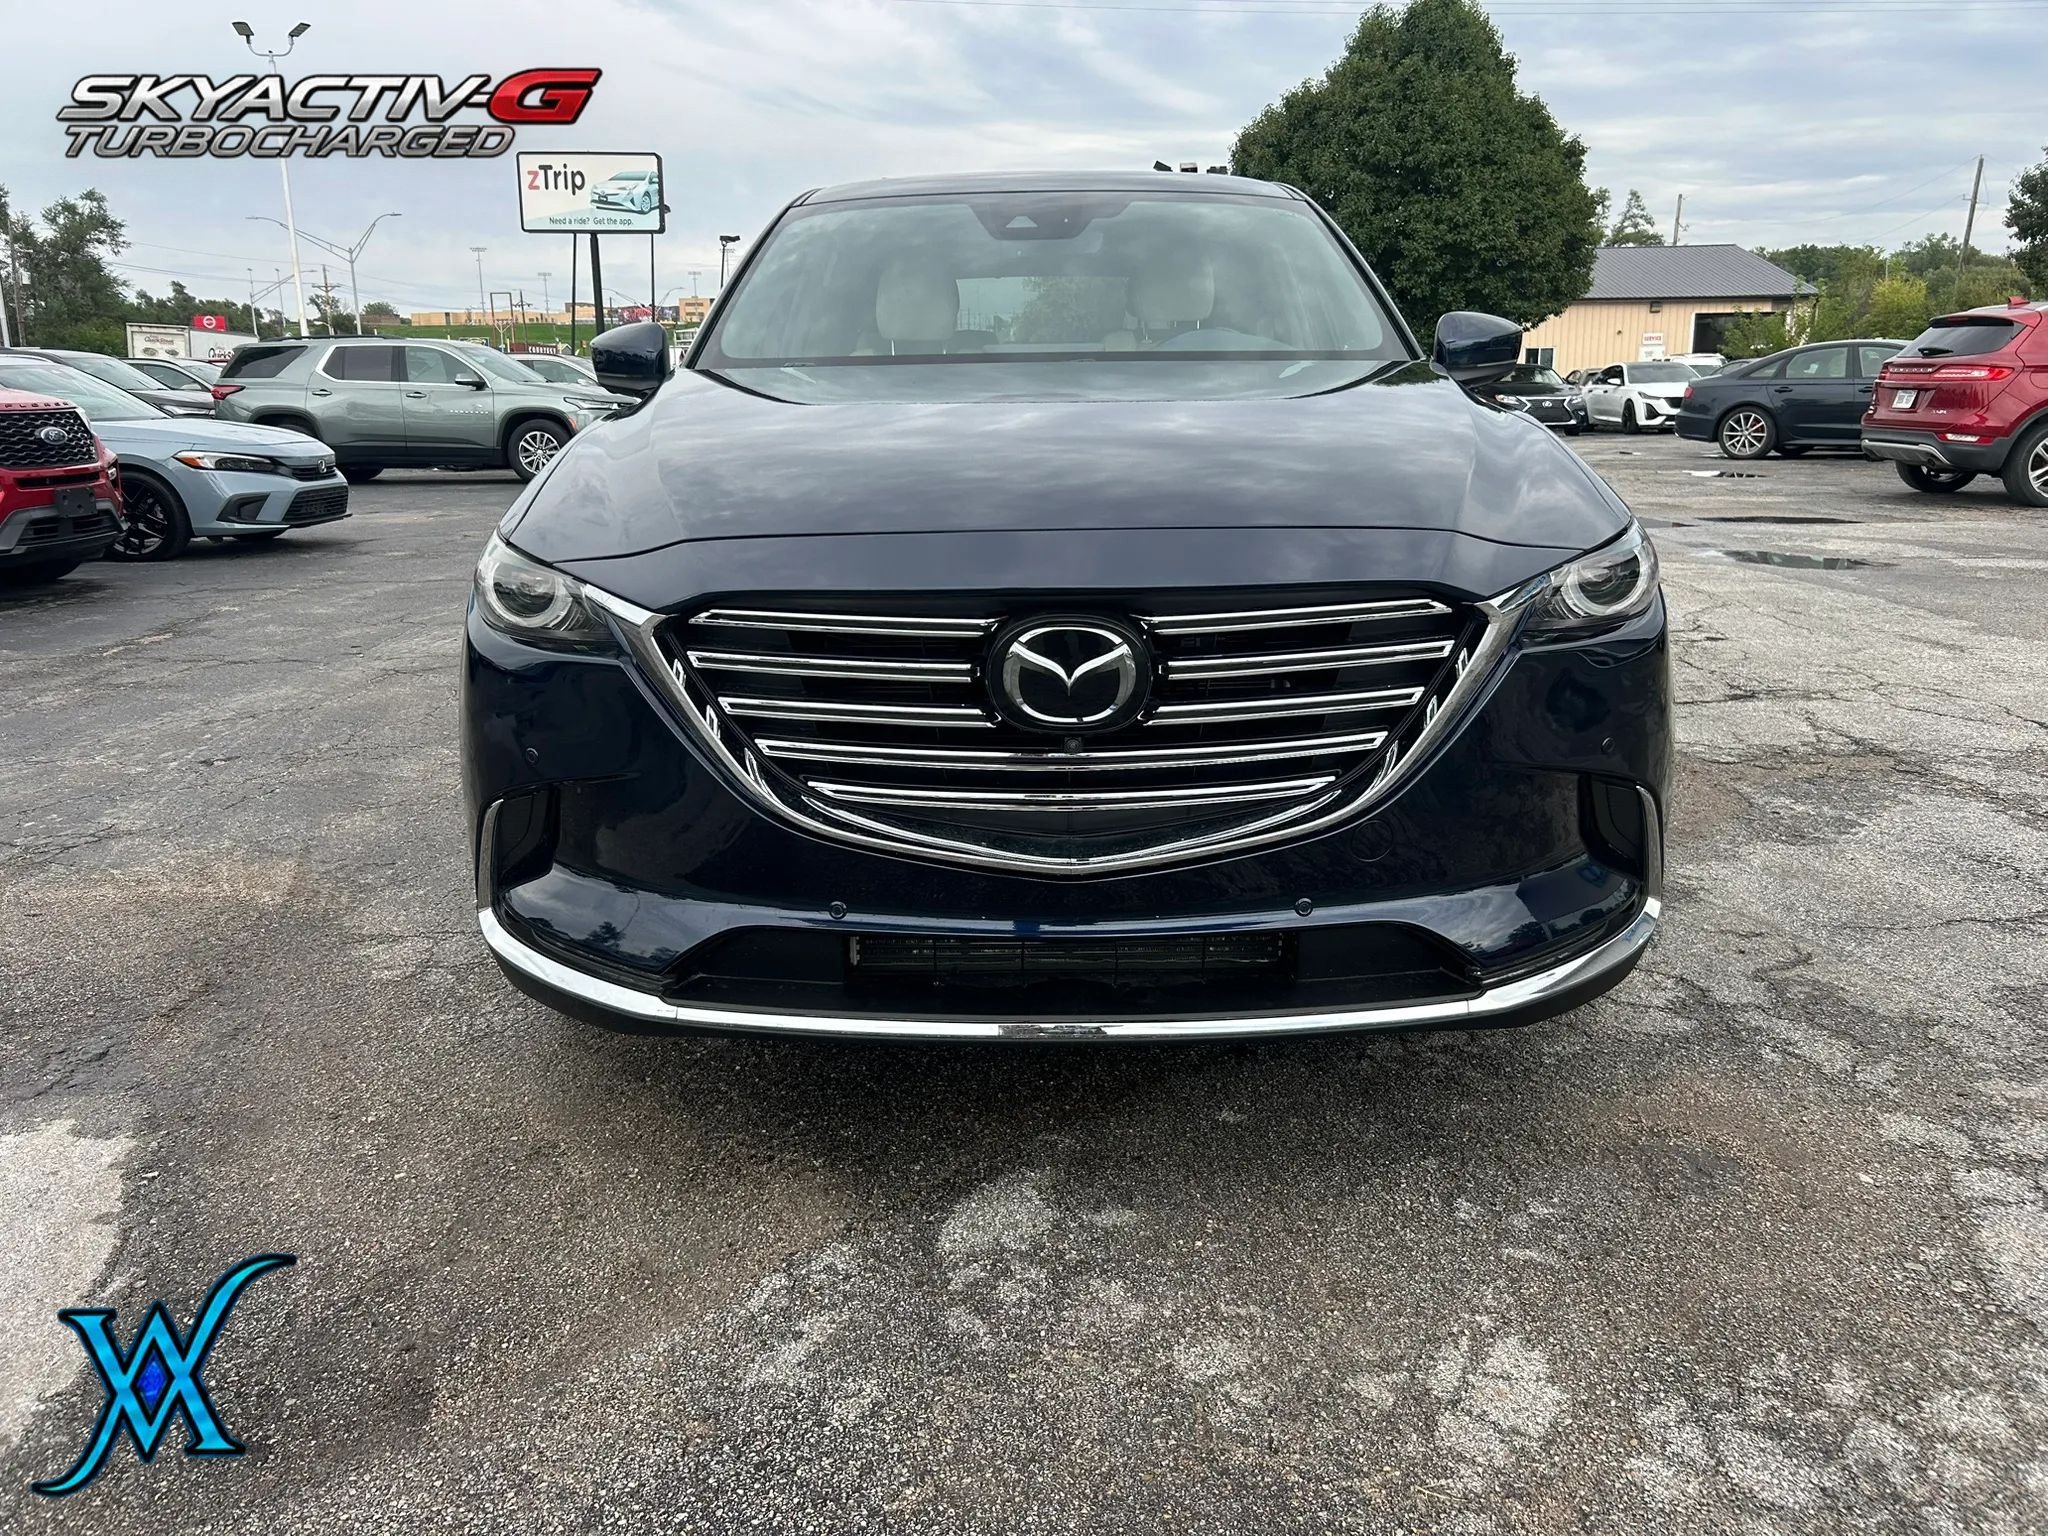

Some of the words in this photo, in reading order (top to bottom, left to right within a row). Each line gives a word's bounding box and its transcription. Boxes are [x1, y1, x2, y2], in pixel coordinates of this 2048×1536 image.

[527, 163, 586, 196] zTrip
[549, 217, 567, 225] Need
[574, 216, 590, 225] ride?
[593, 217, 606, 225] Get
[606, 217, 618, 225] the
[619, 218, 634, 226] app.
